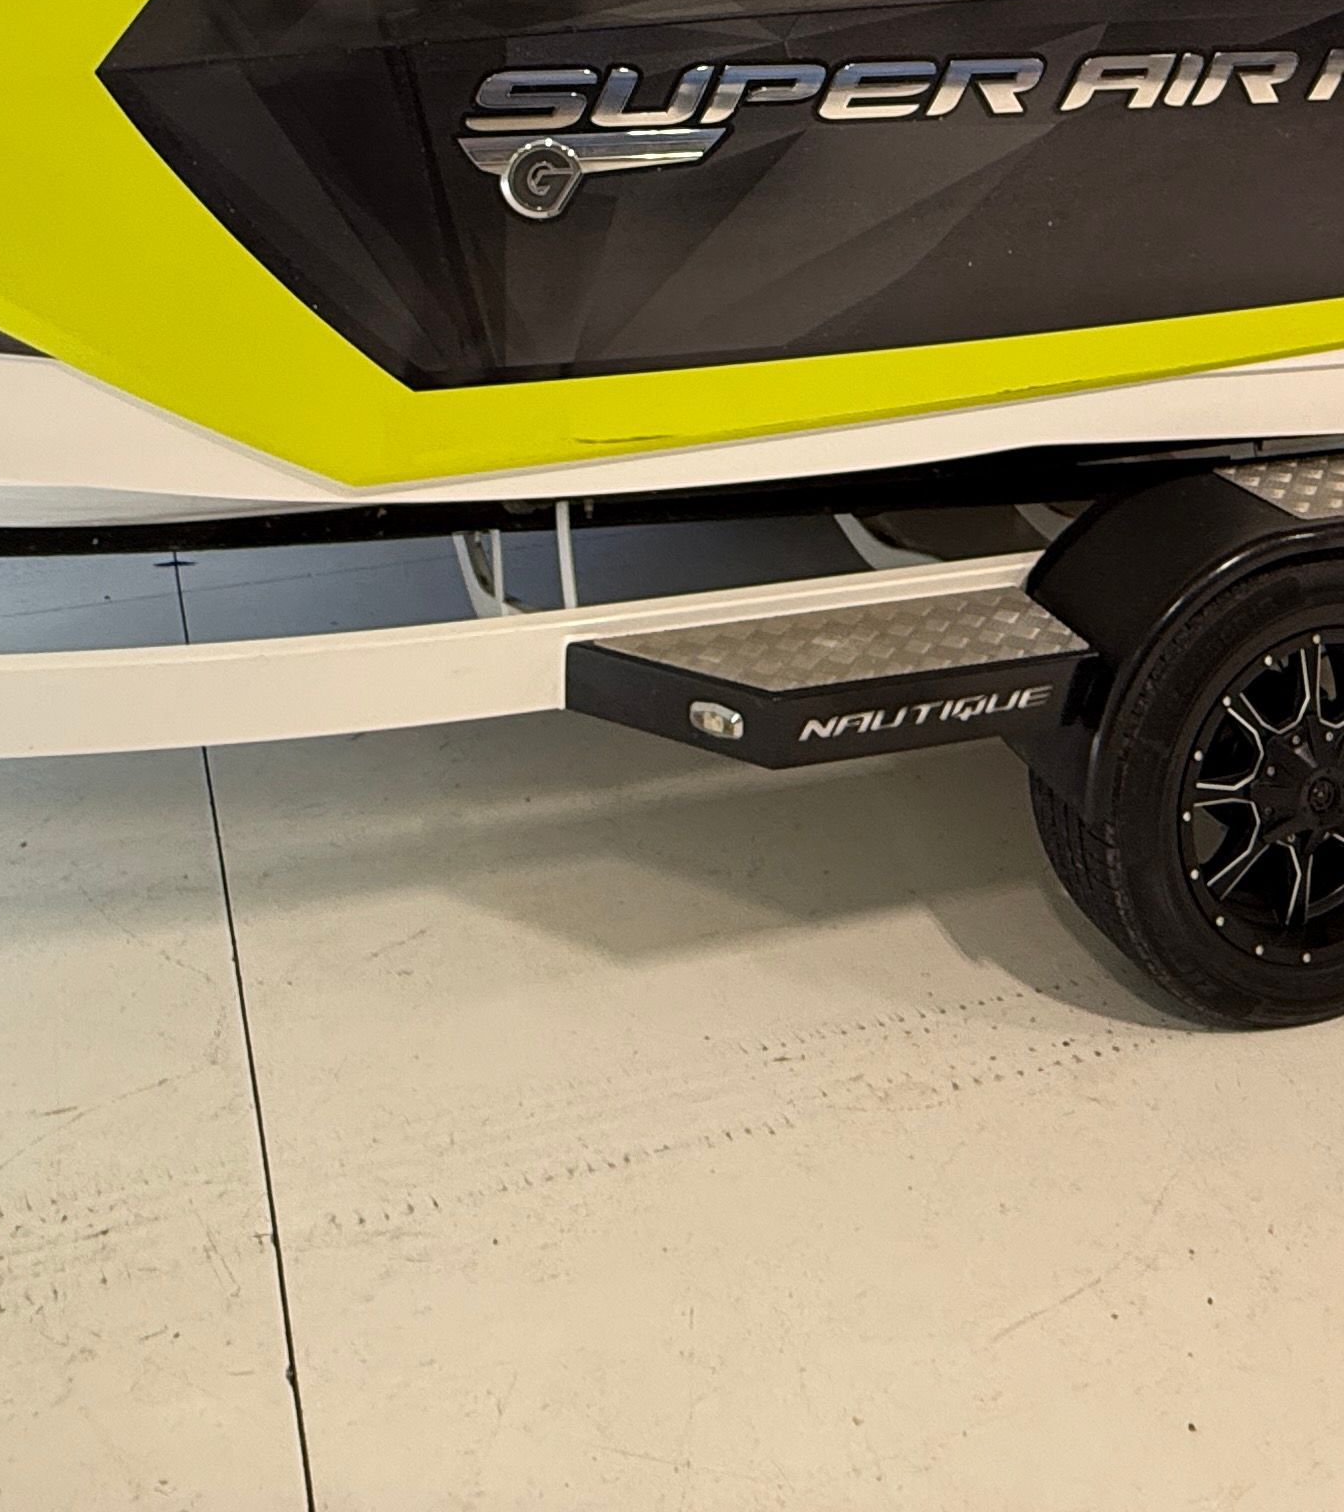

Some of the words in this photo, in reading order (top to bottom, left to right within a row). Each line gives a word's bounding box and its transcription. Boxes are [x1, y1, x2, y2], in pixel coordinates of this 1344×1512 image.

[465, 57, 1047, 132] SUPER
[1060, 51, 1299, 111] AIR
[798, 685, 1054, 742] NAUTIQUE
